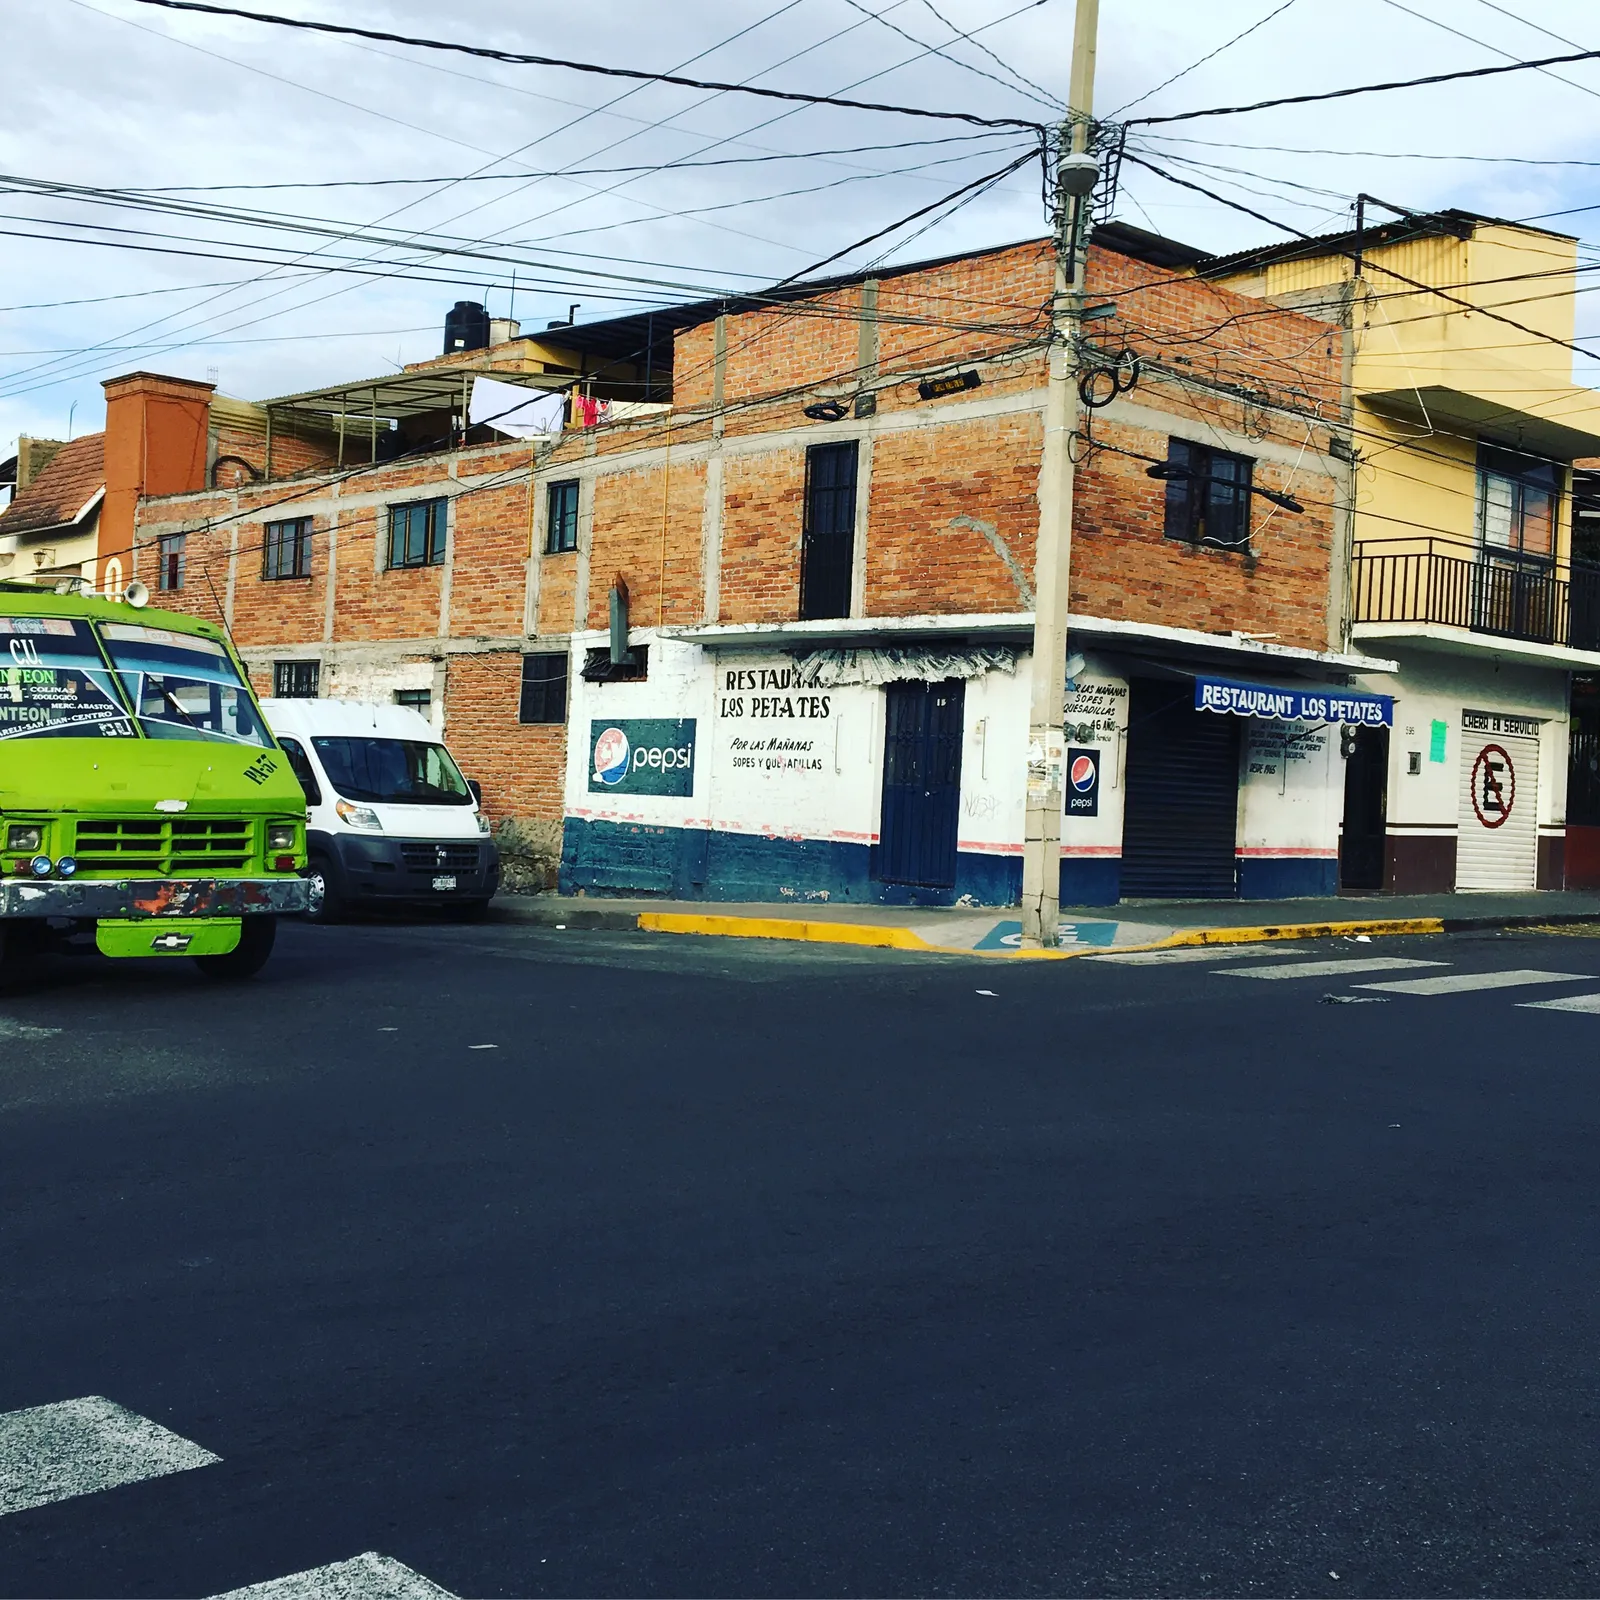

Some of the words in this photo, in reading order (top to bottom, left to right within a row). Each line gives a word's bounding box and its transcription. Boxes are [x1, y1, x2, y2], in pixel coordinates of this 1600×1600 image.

[9, 638, 42, 665] C.U.
[30, 686, 76, 694] COLINAS
[1075, 694, 1103, 705] SOPES
[1202, 684, 1294, 714] RESTAURANT
[1301, 697, 1327, 717] LOS
[1330, 700, 1383, 721] PETATES
[77, 703, 114, 711] ABASTOS
[720, 697, 744, 718] LOS
[751, 695, 831, 719] PETATES
[1063, 703, 1116, 716] QUESADILLAS
[1461, 714, 1489, 730] CHERA
[1503, 719, 1540, 736] SERVICIO
[749, 740, 766, 751] LAS
[766, 738, 814, 752] MAÑANAS
[633, 743, 692, 774] pepsi
[733, 757, 755, 768] SOPES
[759, 759, 763, 767] Y
[765, 758, 822, 770] QUEADLLAS
[1071, 797, 1092, 809] pepsi
